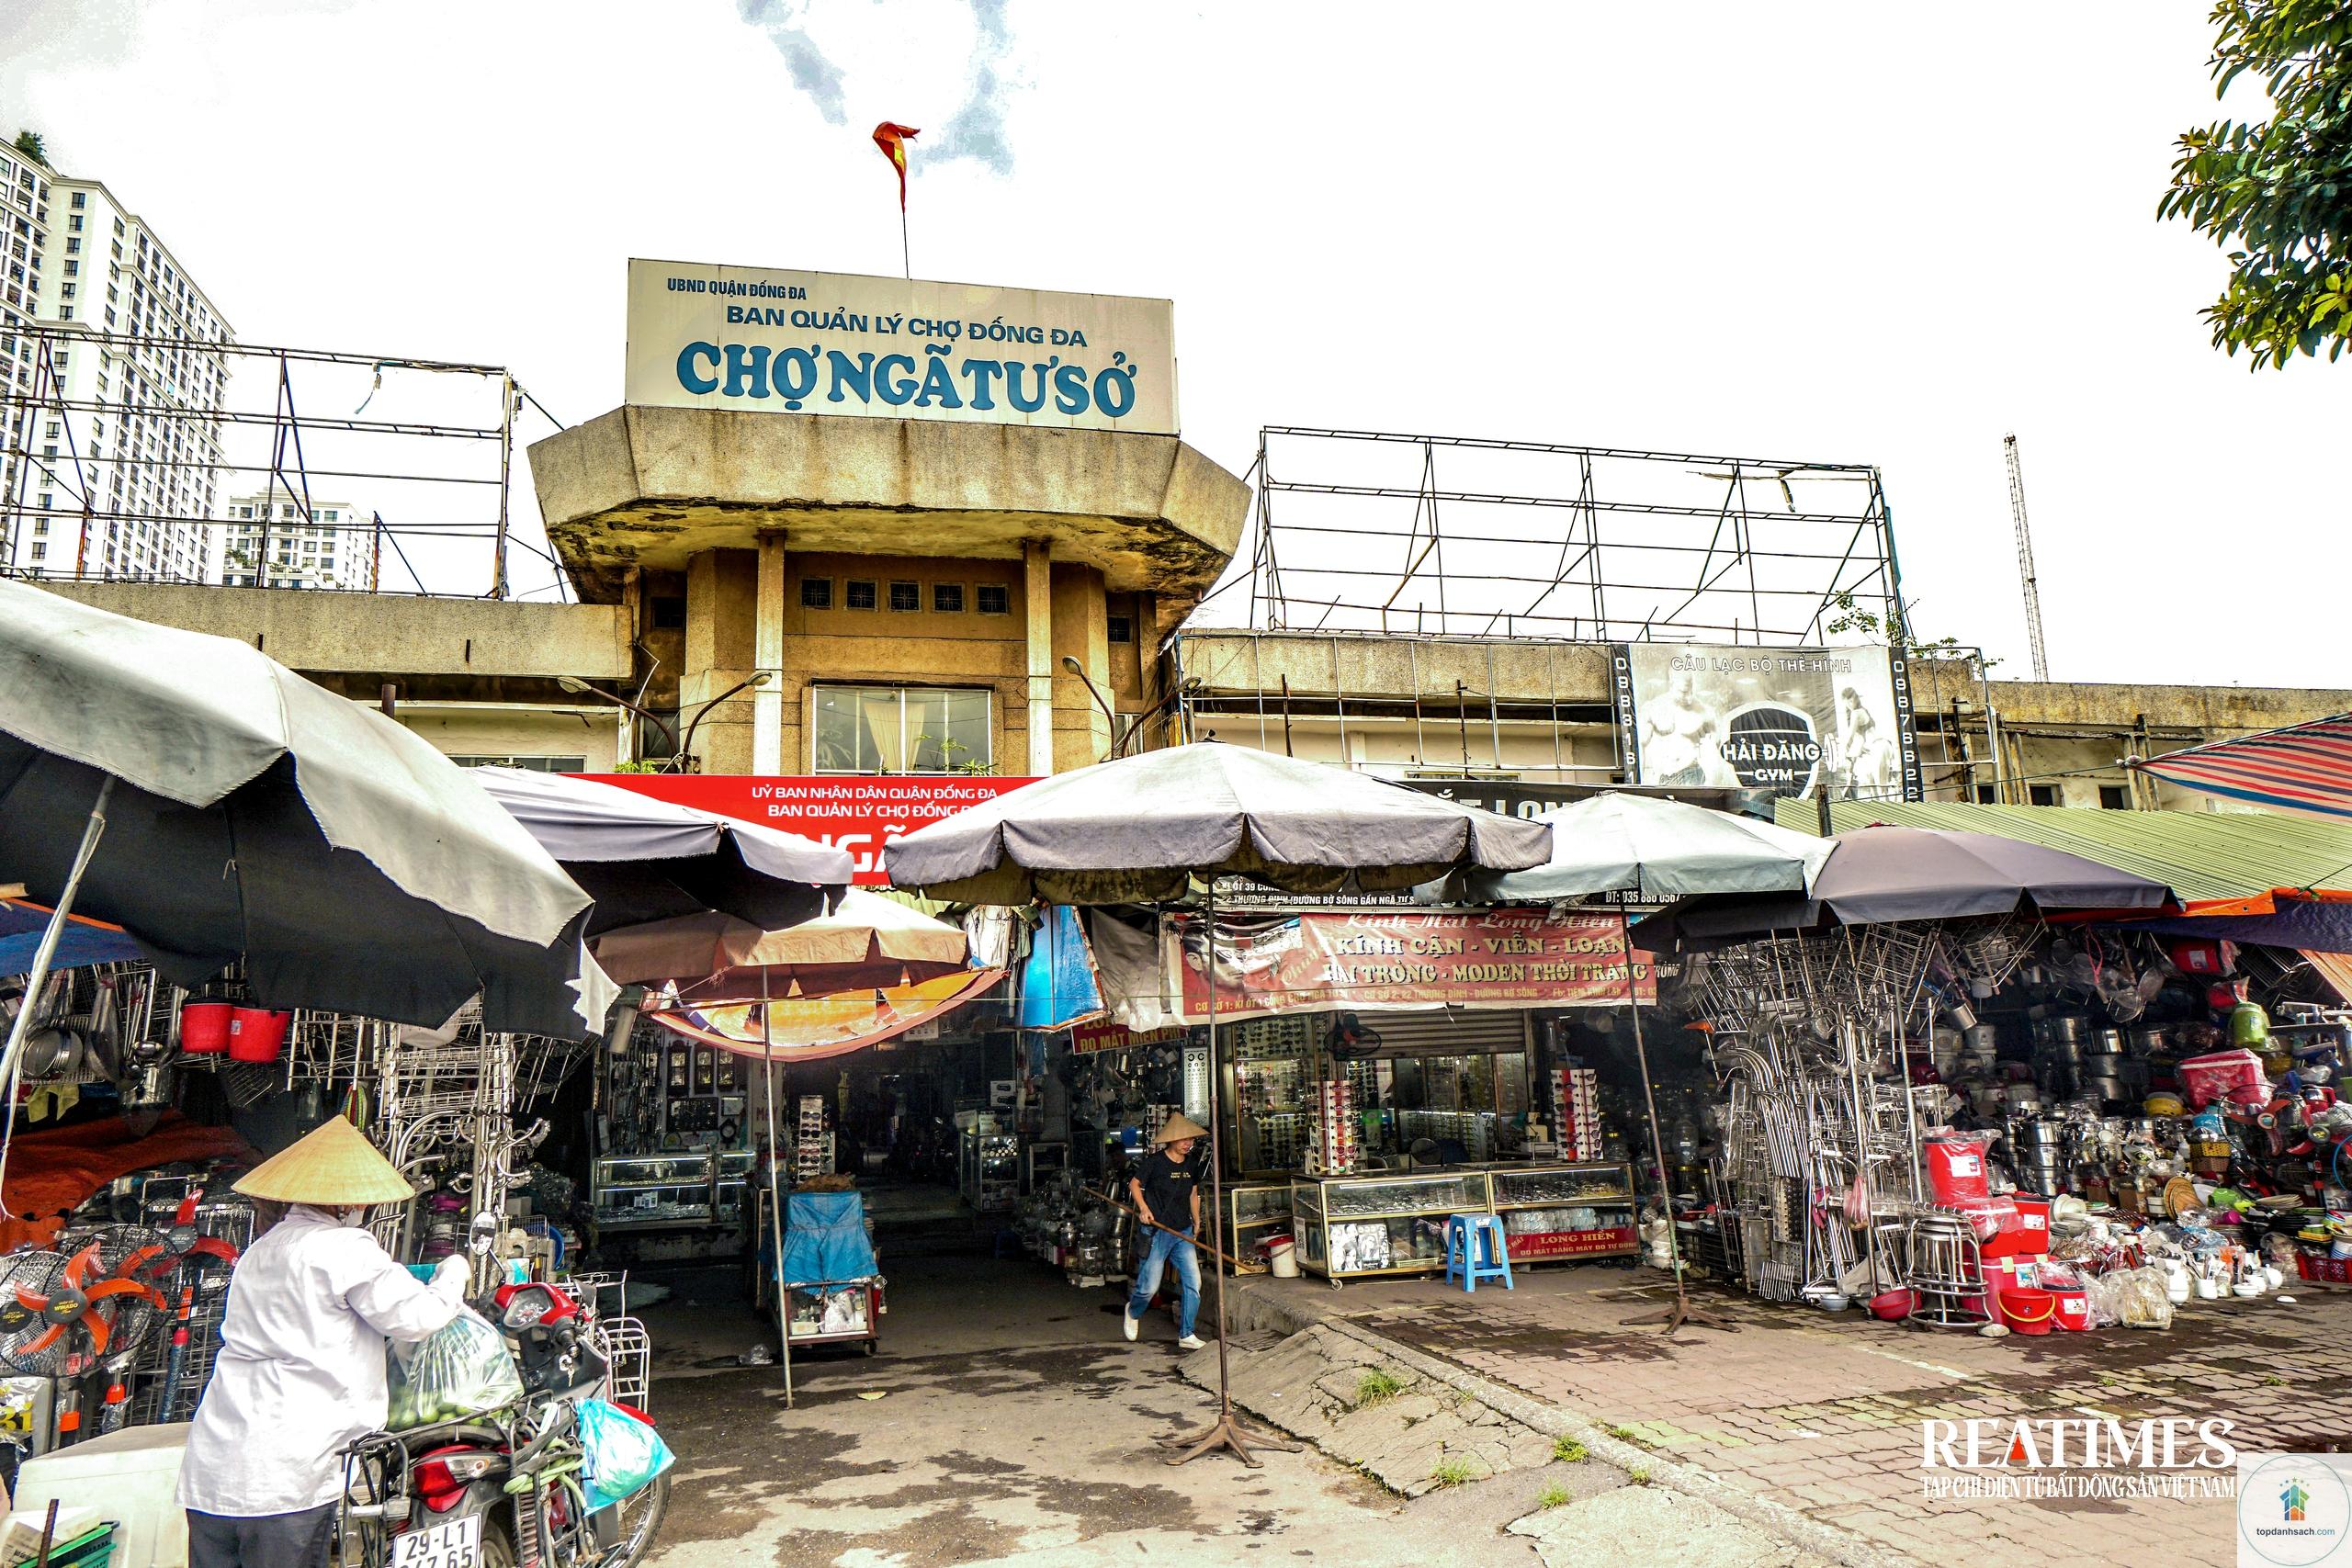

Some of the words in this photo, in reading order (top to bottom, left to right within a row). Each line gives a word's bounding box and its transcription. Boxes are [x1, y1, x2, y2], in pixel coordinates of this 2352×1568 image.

[667, 277, 706, 293] UBND
[708, 279, 747, 298] QUẬN
[749, 280, 786, 299] ĐỐNG
[788, 286, 807, 300] ĐA
[727, 306, 785, 327] BAN
[791, 306, 868, 333] QUẢN
[876, 311, 904, 334] LÝ
[908, 318, 963, 342] CHỢ
[968, 315, 1044, 344] ĐỐNG
[1050, 327, 1089, 347] ĐA
[676, 341, 820, 411] CHỢ
[826, 344, 963, 410] NGÃ
[962, 355, 1059, 412] TƯ
[1054, 350, 1137, 418] SỞ
[1713, 657, 1745, 675] LẠC
[1749, 655, 1772, 675] BỘ
[1778, 653, 1806, 672] THỂ
[1812, 656, 1852, 673] HÌNH
[1723, 738, 1757, 761] HẢI
[1763, 739, 1822, 761] ĐĂNG
[1754, 769, 1792, 781] GYM
[752, 784, 773, 799] UỶ
[775, 787, 807, 798] BAN
[810, 784, 853, 799] NHÂN
[855, 785, 887, 799] DÂN
[889, 785, 931, 800] QUẬN
[933, 784, 975, 799] ĐỐNG
[978, 788, 997, 799] ĐA
[768, 805, 803, 817] BAN
[806, 802, 853, 818] QUẢN
[855, 802, 873, 817] LÝ
[876, 804, 910, 818] CHỢ
[911, 800, 959, 817] ĐỐNG
[1336, 895, 1359, 905] SÔNG
[1379, 894, 1396, 905] NGÃ
[1606, 891, 1620, 903] ĐT:
[1623, 891, 1638, 903] 035
[1476, 912, 1544, 931] Long
[1336, 934, 1404, 956] KÍNH
[1409, 934, 1464, 959] CẬN
[1483, 931, 1544, 954] VIỄN
[1565, 936, 1626, 957] LOẠN
[1453, 964, 1526, 983] MODEN
[1540, 1235, 1578, 1245] LONG
[406, 1521, 466, 1561] 29-L1
